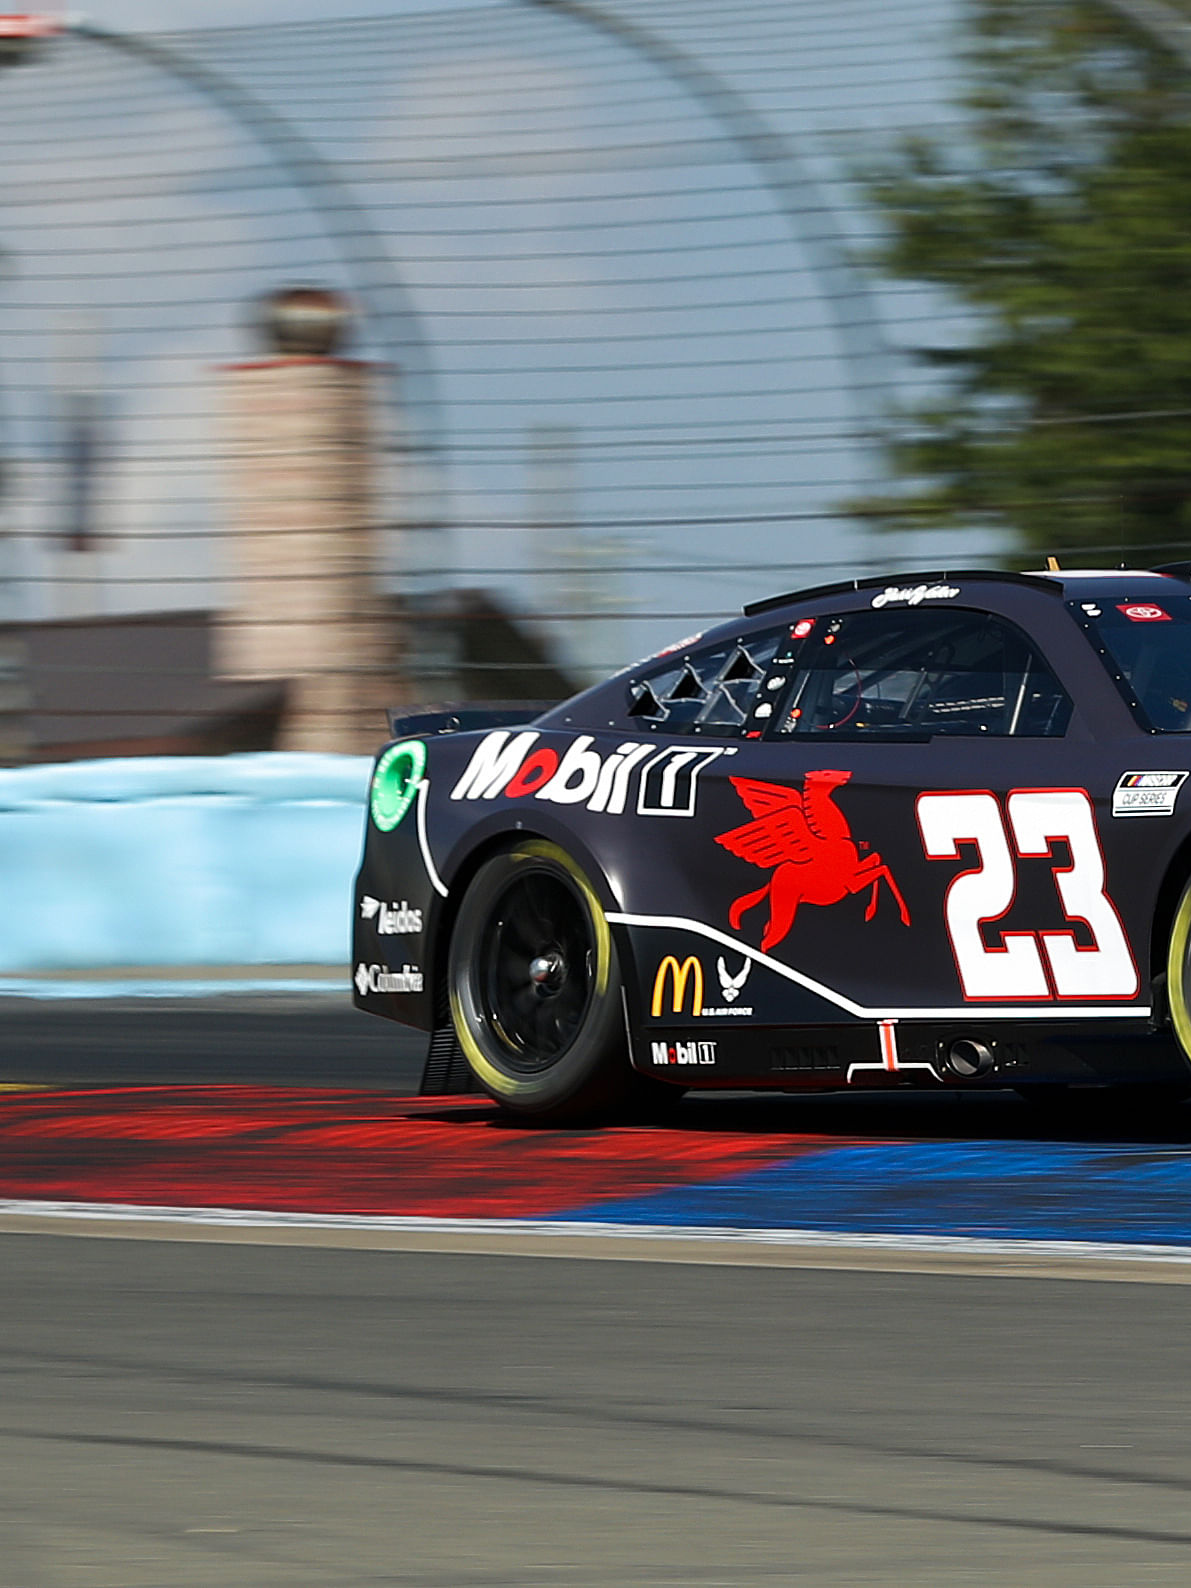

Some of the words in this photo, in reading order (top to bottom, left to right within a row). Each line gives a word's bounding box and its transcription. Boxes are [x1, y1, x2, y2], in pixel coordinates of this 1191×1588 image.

[450, 731, 657, 814] Mobil
[915, 787, 1141, 1000] 23
[651, 1042, 698, 1065] Mobil
